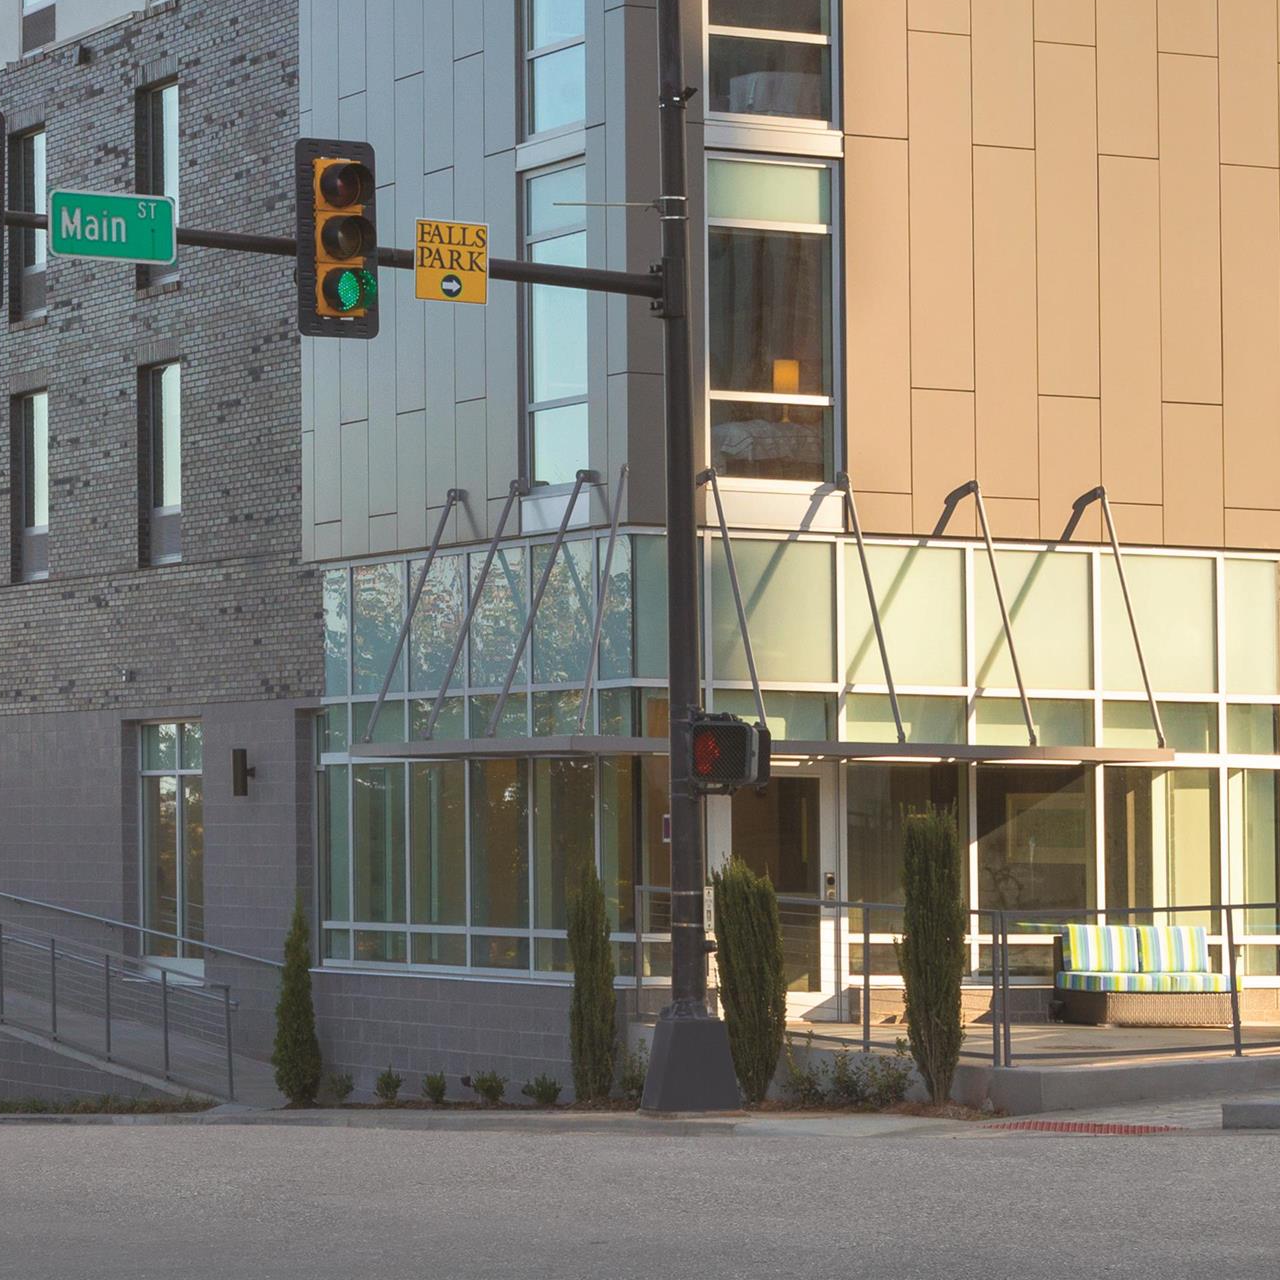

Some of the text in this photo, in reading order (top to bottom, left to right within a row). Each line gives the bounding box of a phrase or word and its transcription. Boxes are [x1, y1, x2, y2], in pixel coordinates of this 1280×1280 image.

[61, 201, 157, 243] Main ST
[417, 222, 486, 248] FALLS
[417, 246, 486, 273] PARK
